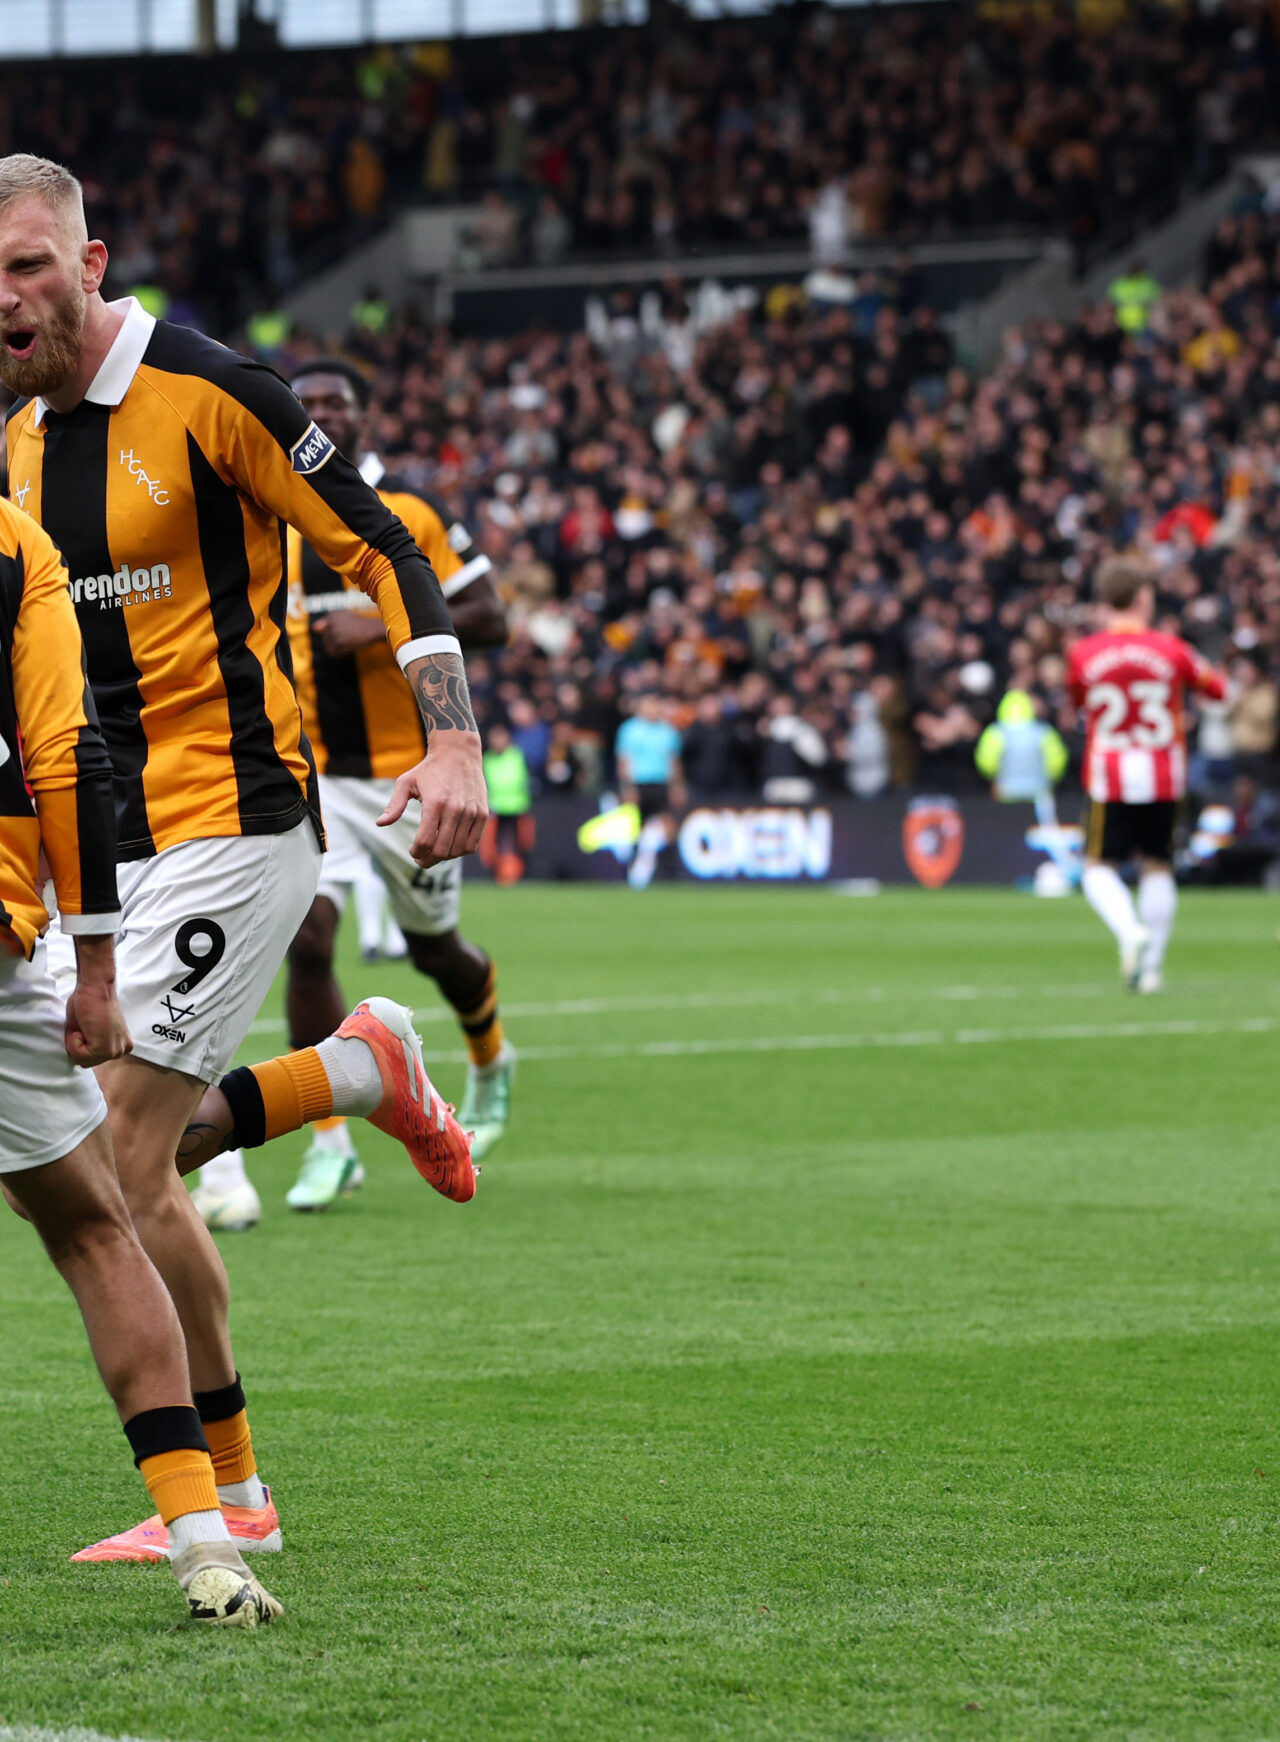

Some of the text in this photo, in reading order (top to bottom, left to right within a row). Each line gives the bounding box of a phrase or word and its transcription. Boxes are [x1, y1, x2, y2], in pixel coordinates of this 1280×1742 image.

[120, 449, 170, 506] HCAFC
[100, 587, 173, 611] AIRLINES
[1085, 681, 1175, 749] 23
[678, 806, 833, 880] OXEN
[171, 917, 226, 995] 9
[151, 1023, 186, 1044] OXEN
